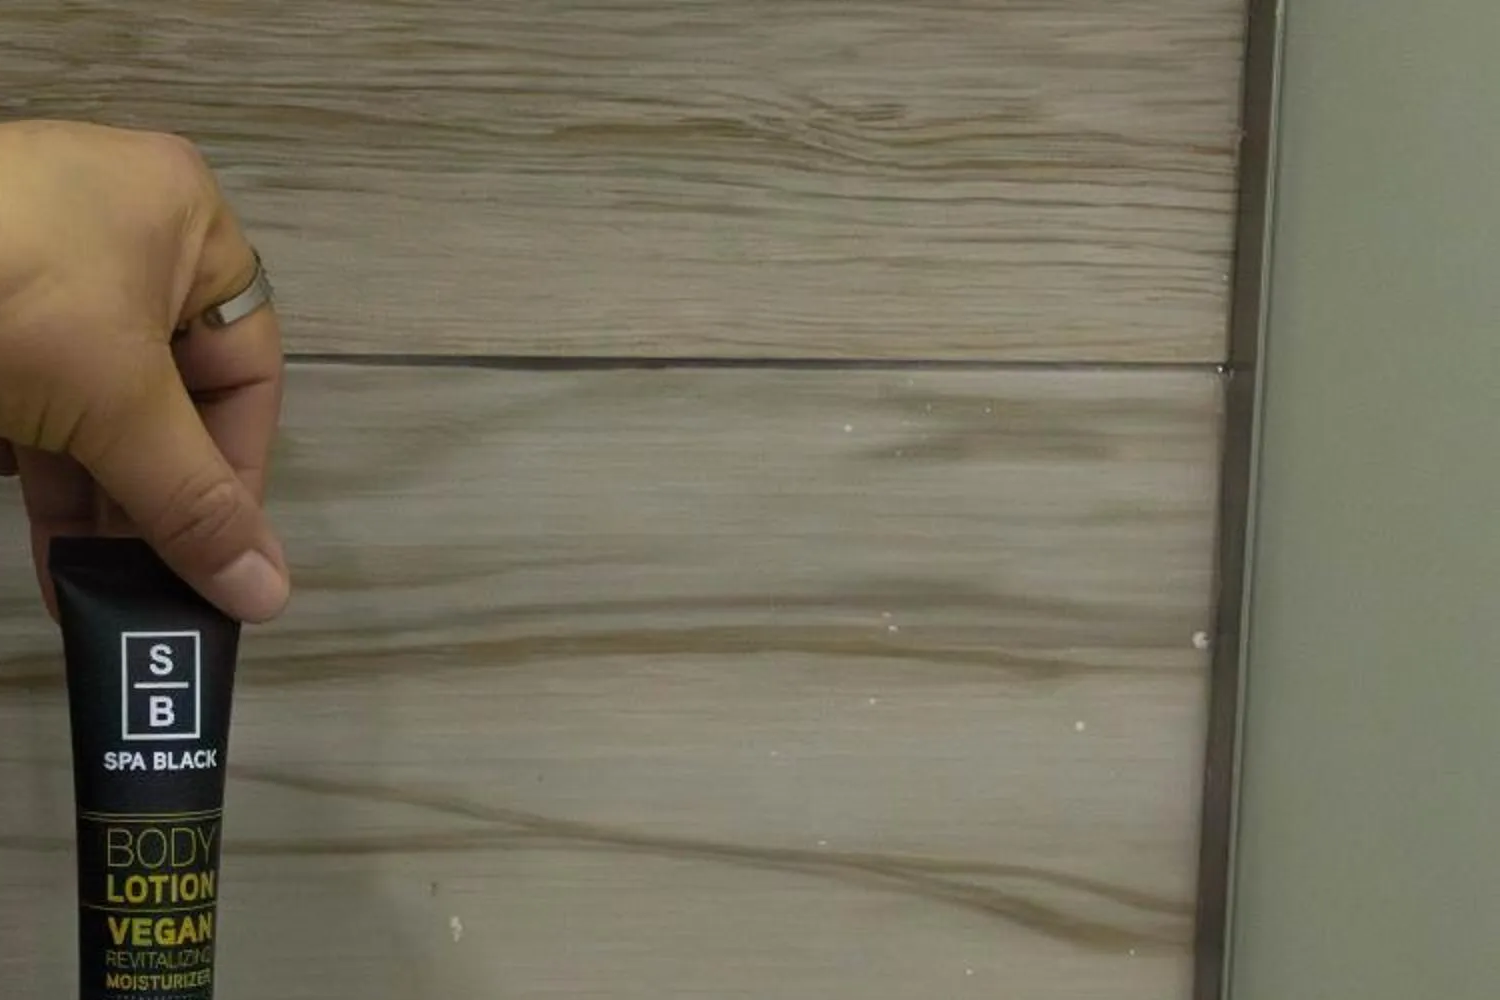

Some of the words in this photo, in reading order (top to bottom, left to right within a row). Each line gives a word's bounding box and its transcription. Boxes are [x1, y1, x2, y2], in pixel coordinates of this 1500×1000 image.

[149, 643, 174, 675] S
[149, 695, 175, 727] B
[103, 751, 146, 771] SPA
[153, 749, 217, 771] BLACK
[106, 827, 216, 868] BODY
[106, 870, 215, 903] LOTION
[107, 912, 213, 946] VEGAN
[105, 968, 211, 991] MOISTURIZER
